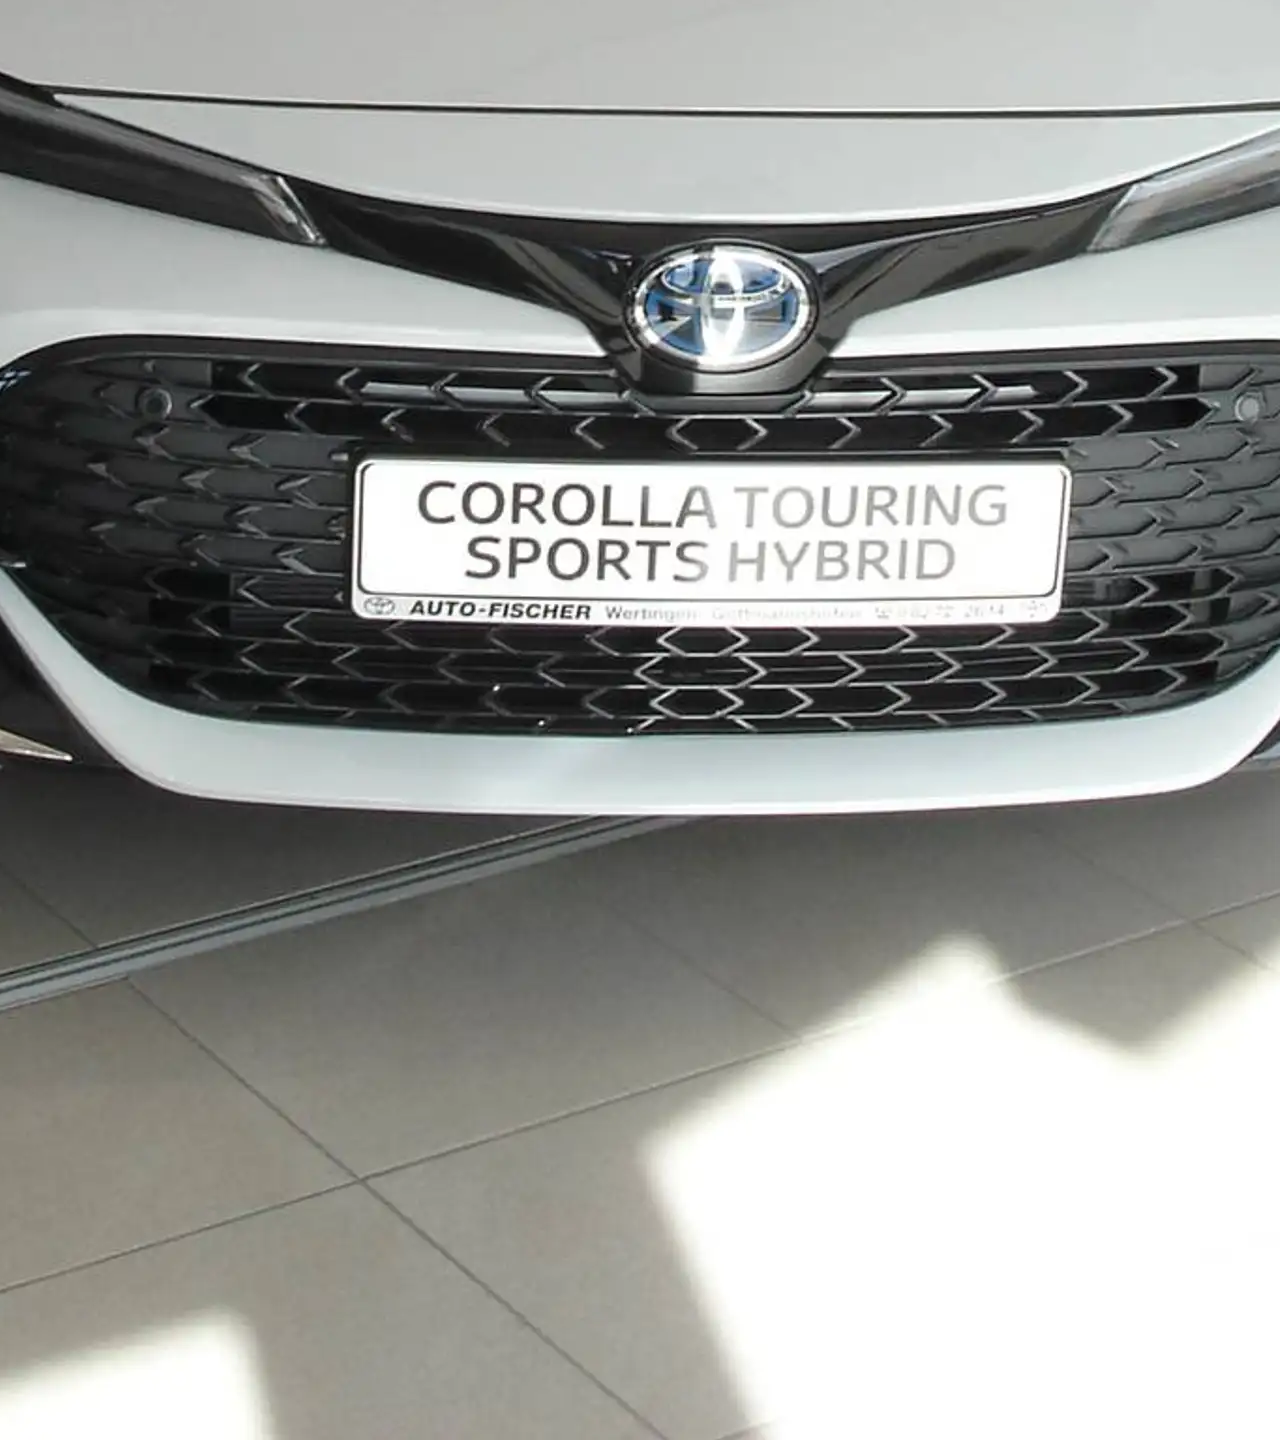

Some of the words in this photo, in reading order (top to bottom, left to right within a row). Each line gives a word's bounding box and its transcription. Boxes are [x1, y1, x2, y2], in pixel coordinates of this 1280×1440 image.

[418, 480, 717, 528] COROLLA
[734, 482, 1009, 528] TOURING
[464, 536, 710, 583] SPORTS
[727, 538, 957, 582] HYBRID
[409, 600, 592, 620] AUTO-FISCHER
